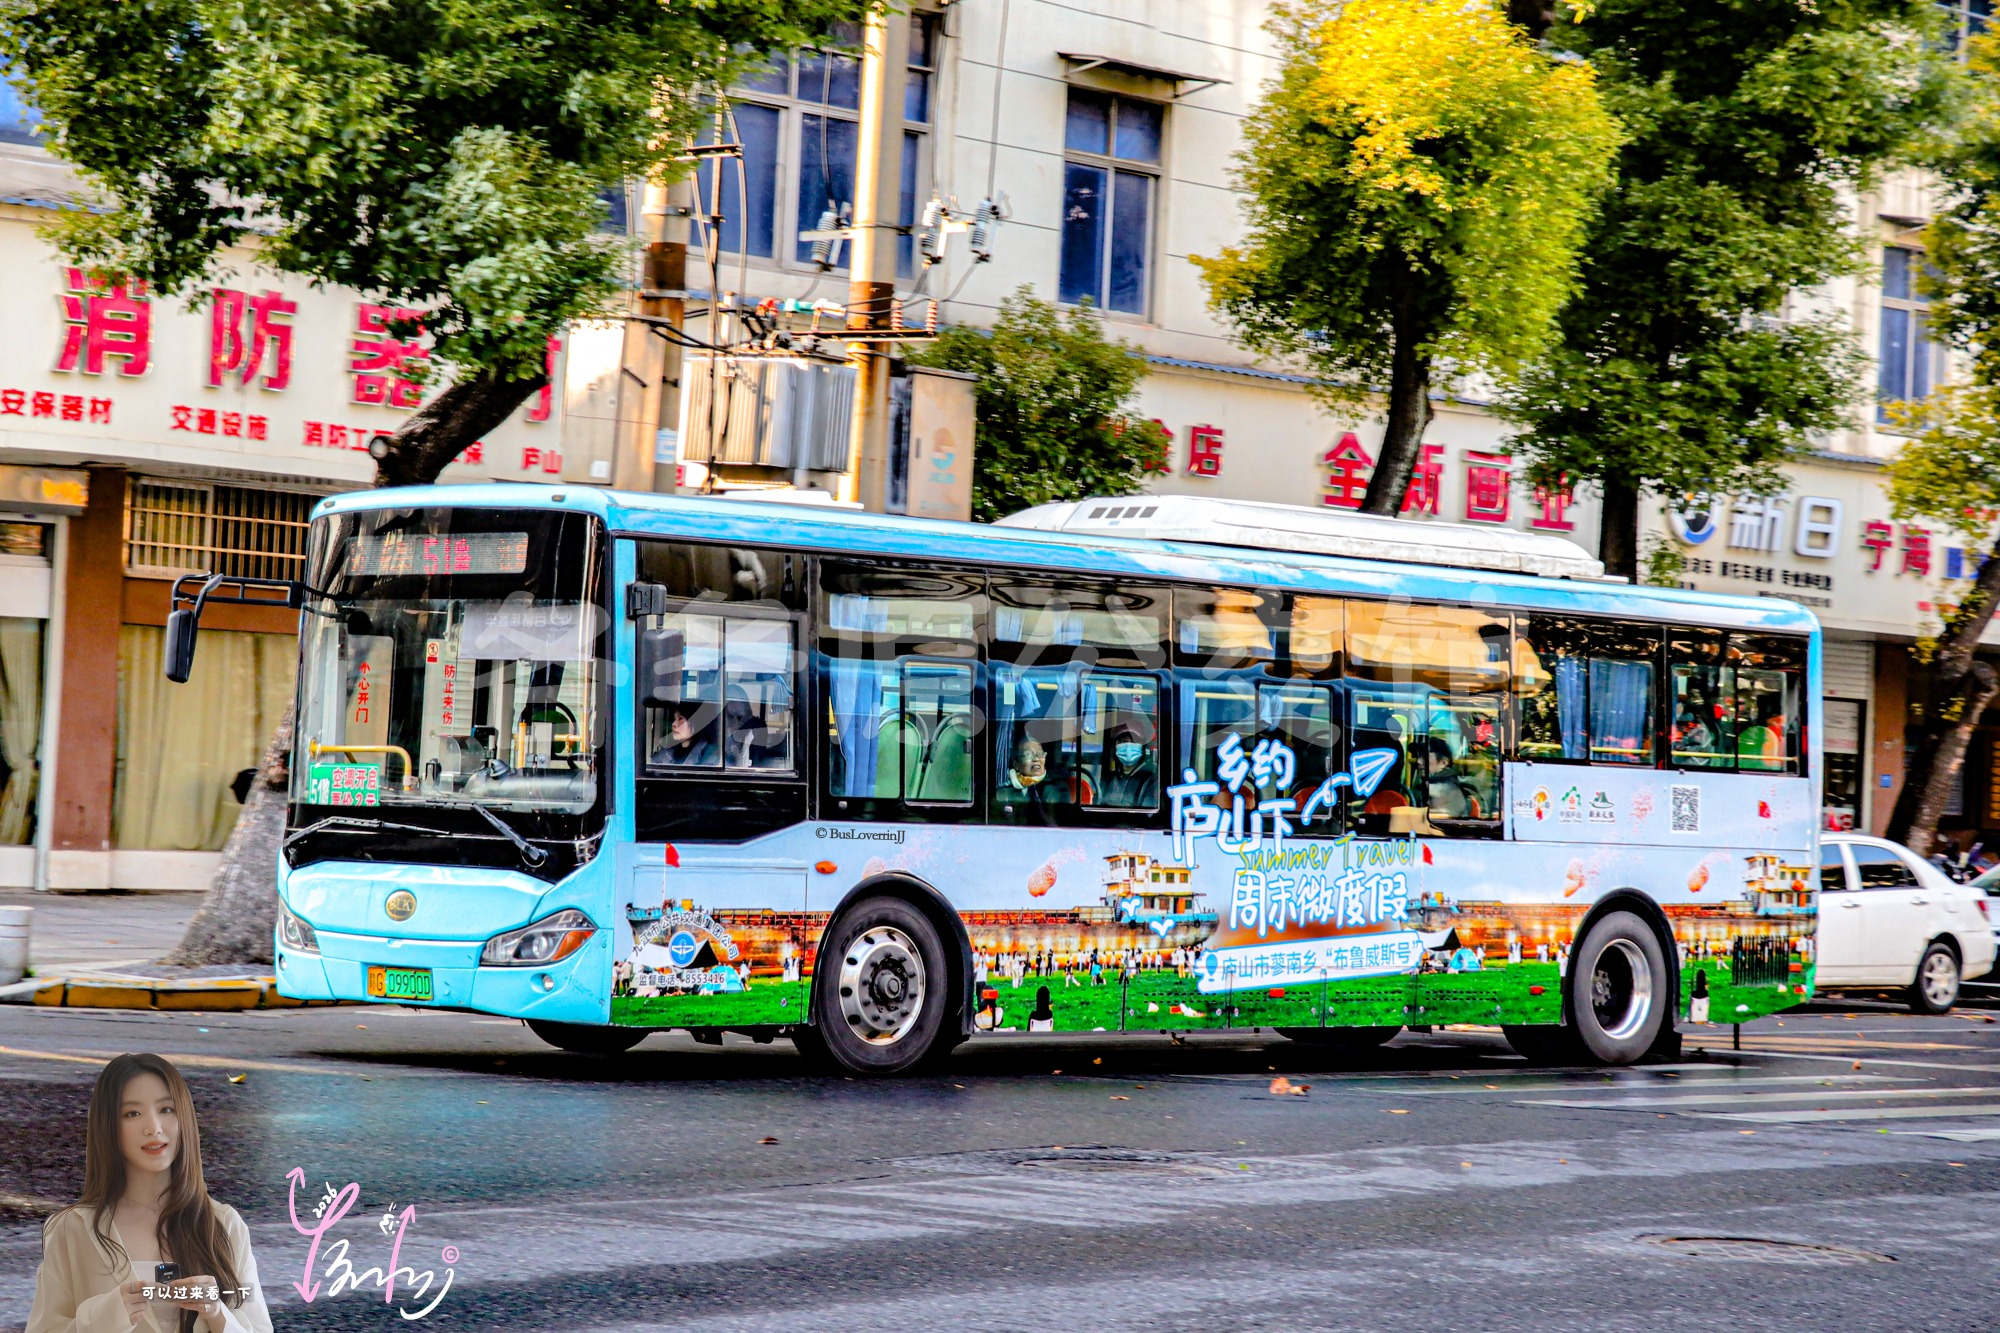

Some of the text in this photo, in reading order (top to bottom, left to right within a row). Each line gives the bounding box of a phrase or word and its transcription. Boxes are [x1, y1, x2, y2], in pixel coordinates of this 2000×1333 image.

[1, 388, 113, 425] 安保器材
[170, 404, 269, 442] 交通设施
[355, 660, 371, 724] 小心开门
[442, 663, 456, 725] 防止夹伤
[332, 768, 377, 790] 空调开启
[1229, 868, 1411, 938] 周末微度假
[631, 911, 739, 960] 九江市公共交通集团公司
